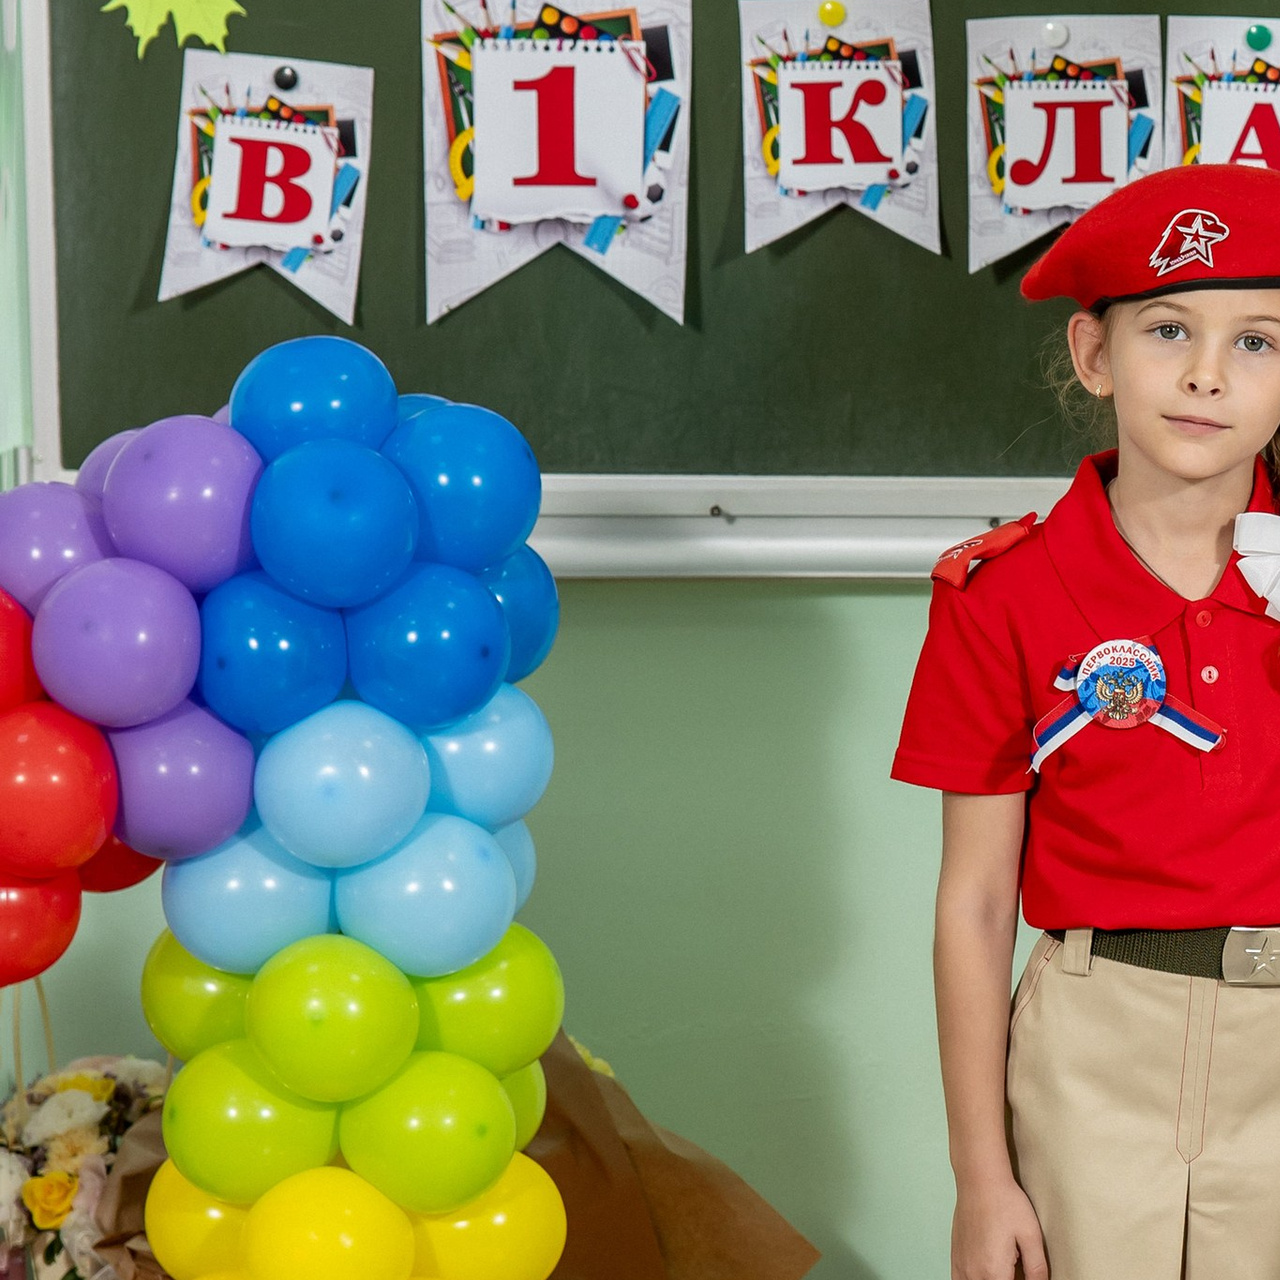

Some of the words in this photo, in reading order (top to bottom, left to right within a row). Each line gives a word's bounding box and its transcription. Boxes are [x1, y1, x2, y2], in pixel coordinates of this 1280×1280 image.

[228, 138, 313, 225] В
[512, 66, 598, 187] 1
[1082, 645, 1161, 681] ПЕРВОКЛАССНИК
[1109, 655, 1135, 667] 2025
